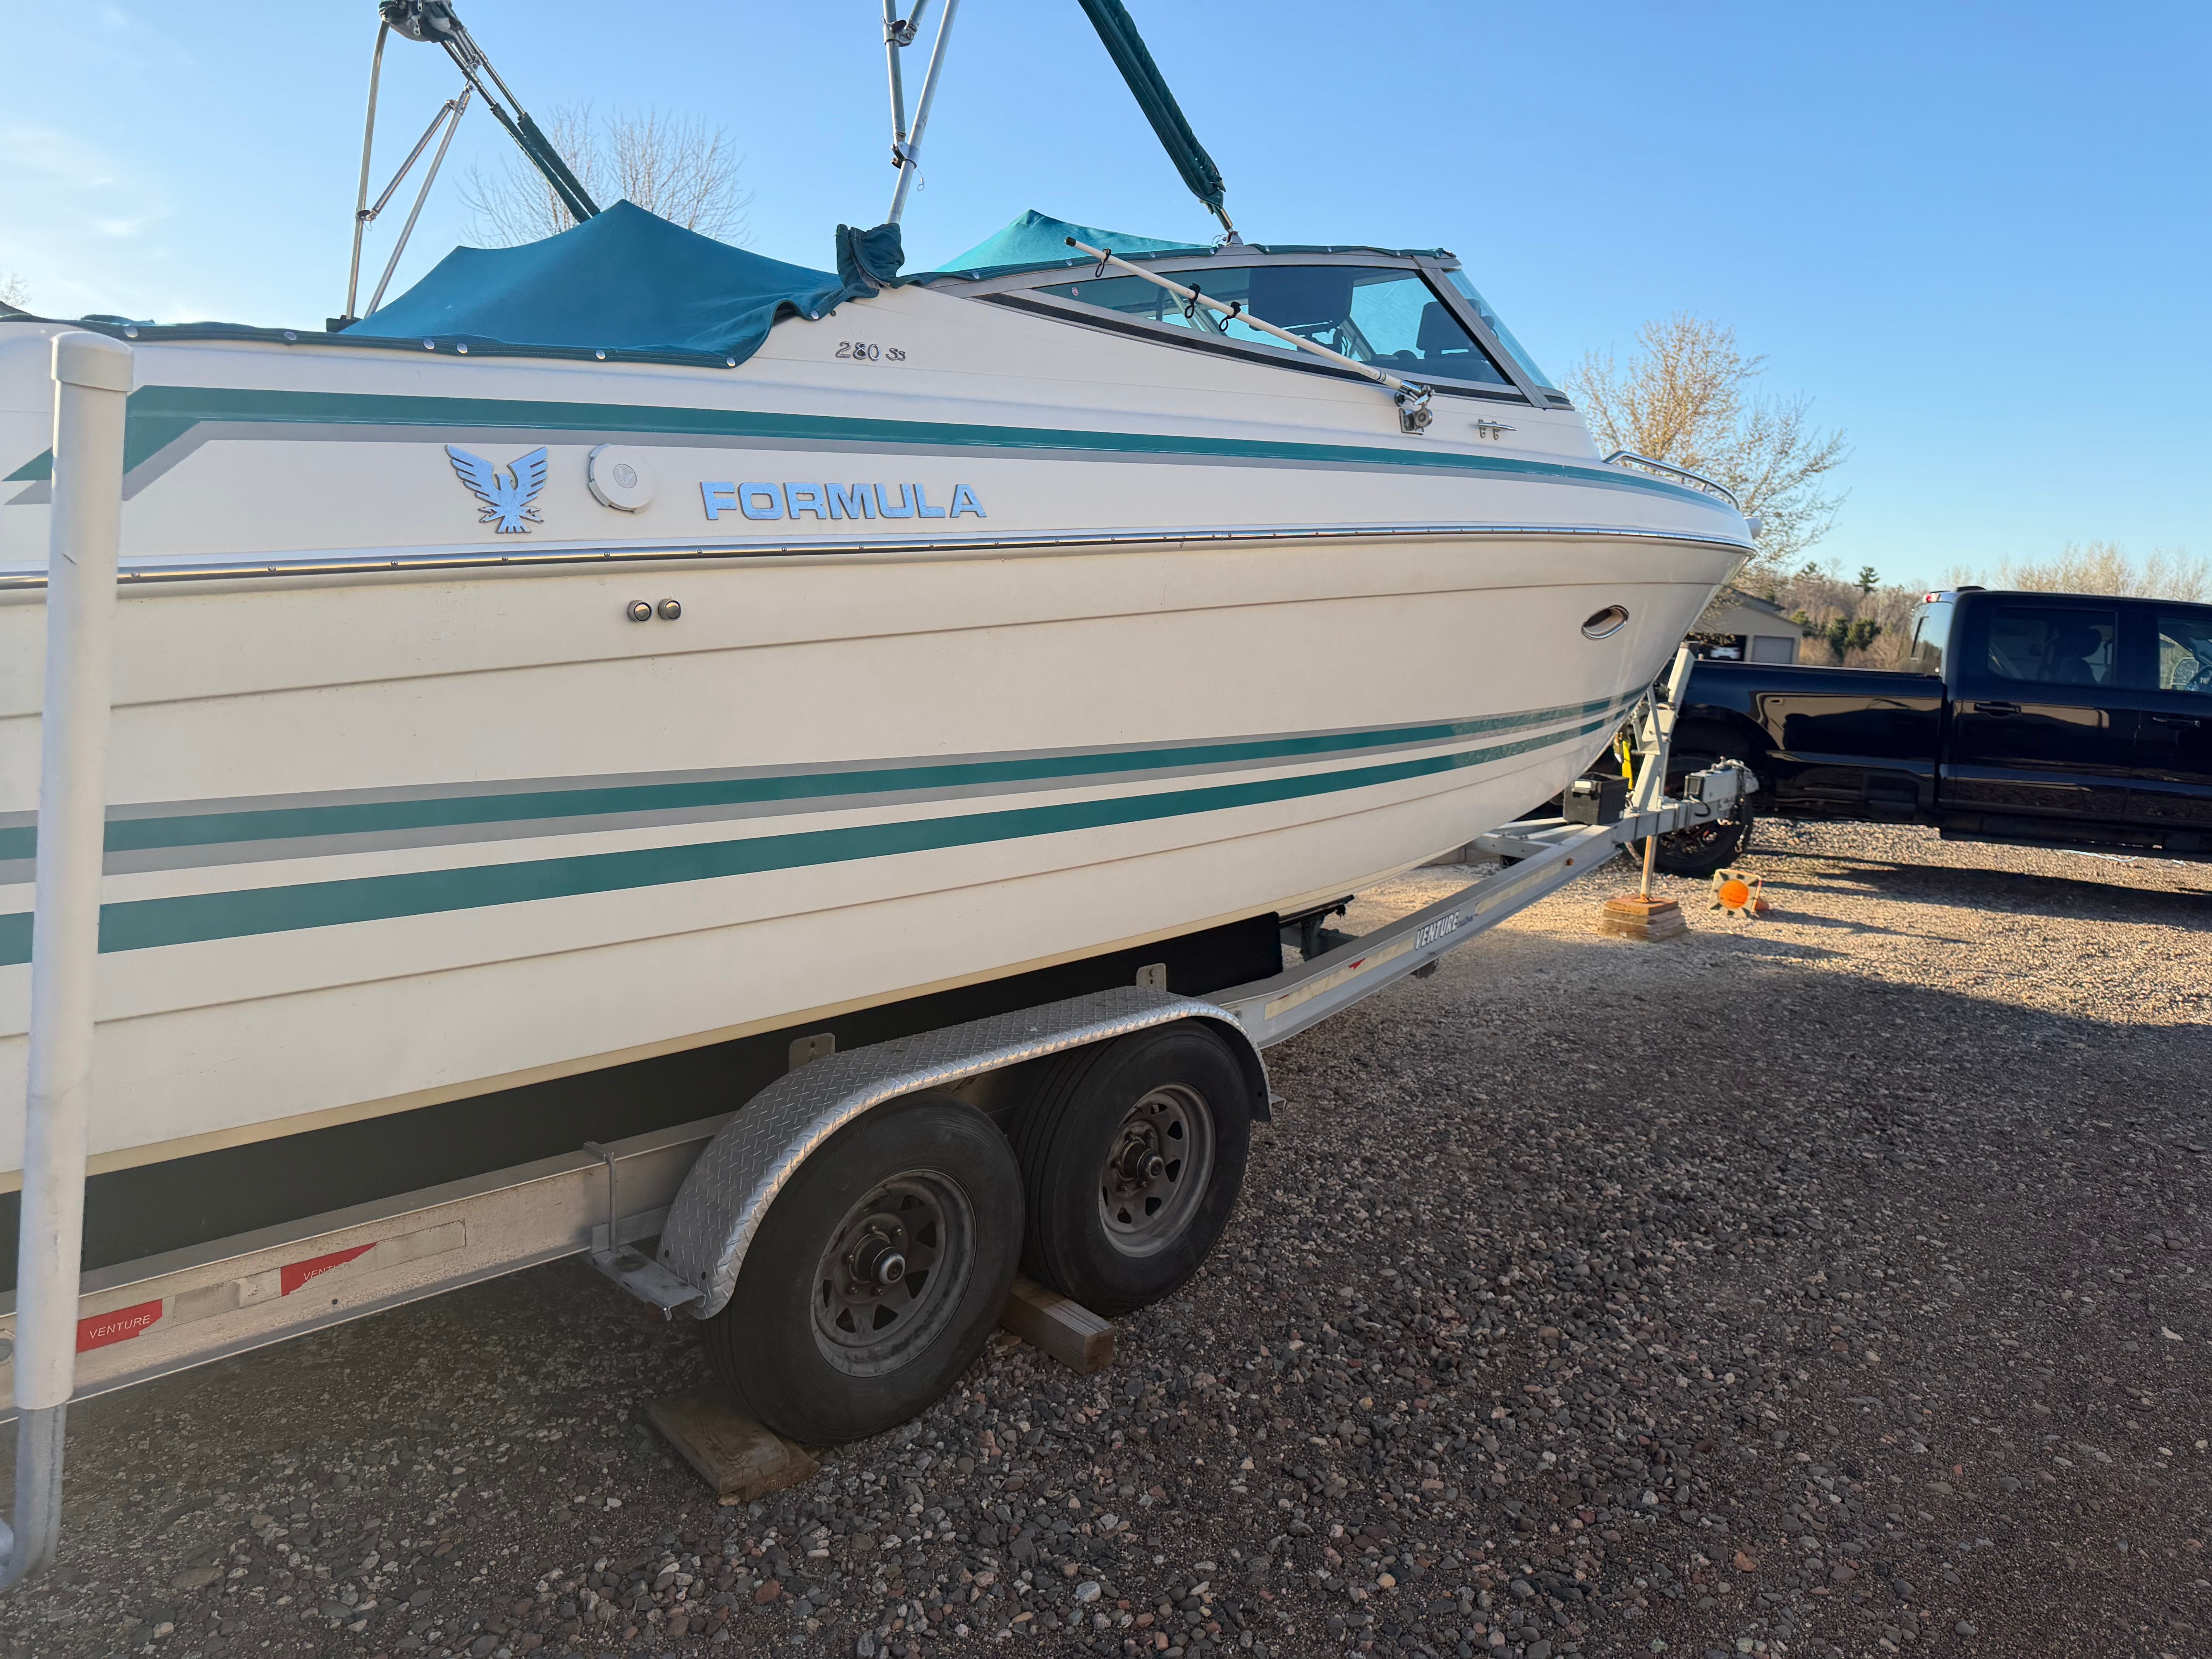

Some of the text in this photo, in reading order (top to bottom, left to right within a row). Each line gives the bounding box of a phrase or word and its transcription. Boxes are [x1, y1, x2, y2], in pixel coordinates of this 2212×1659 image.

[835, 341, 881, 361] 280
[699, 481, 987, 520] FORMULA
[1415, 910, 1459, 950] VENTURE
[90, 1315, 150, 1339] VENTURE
